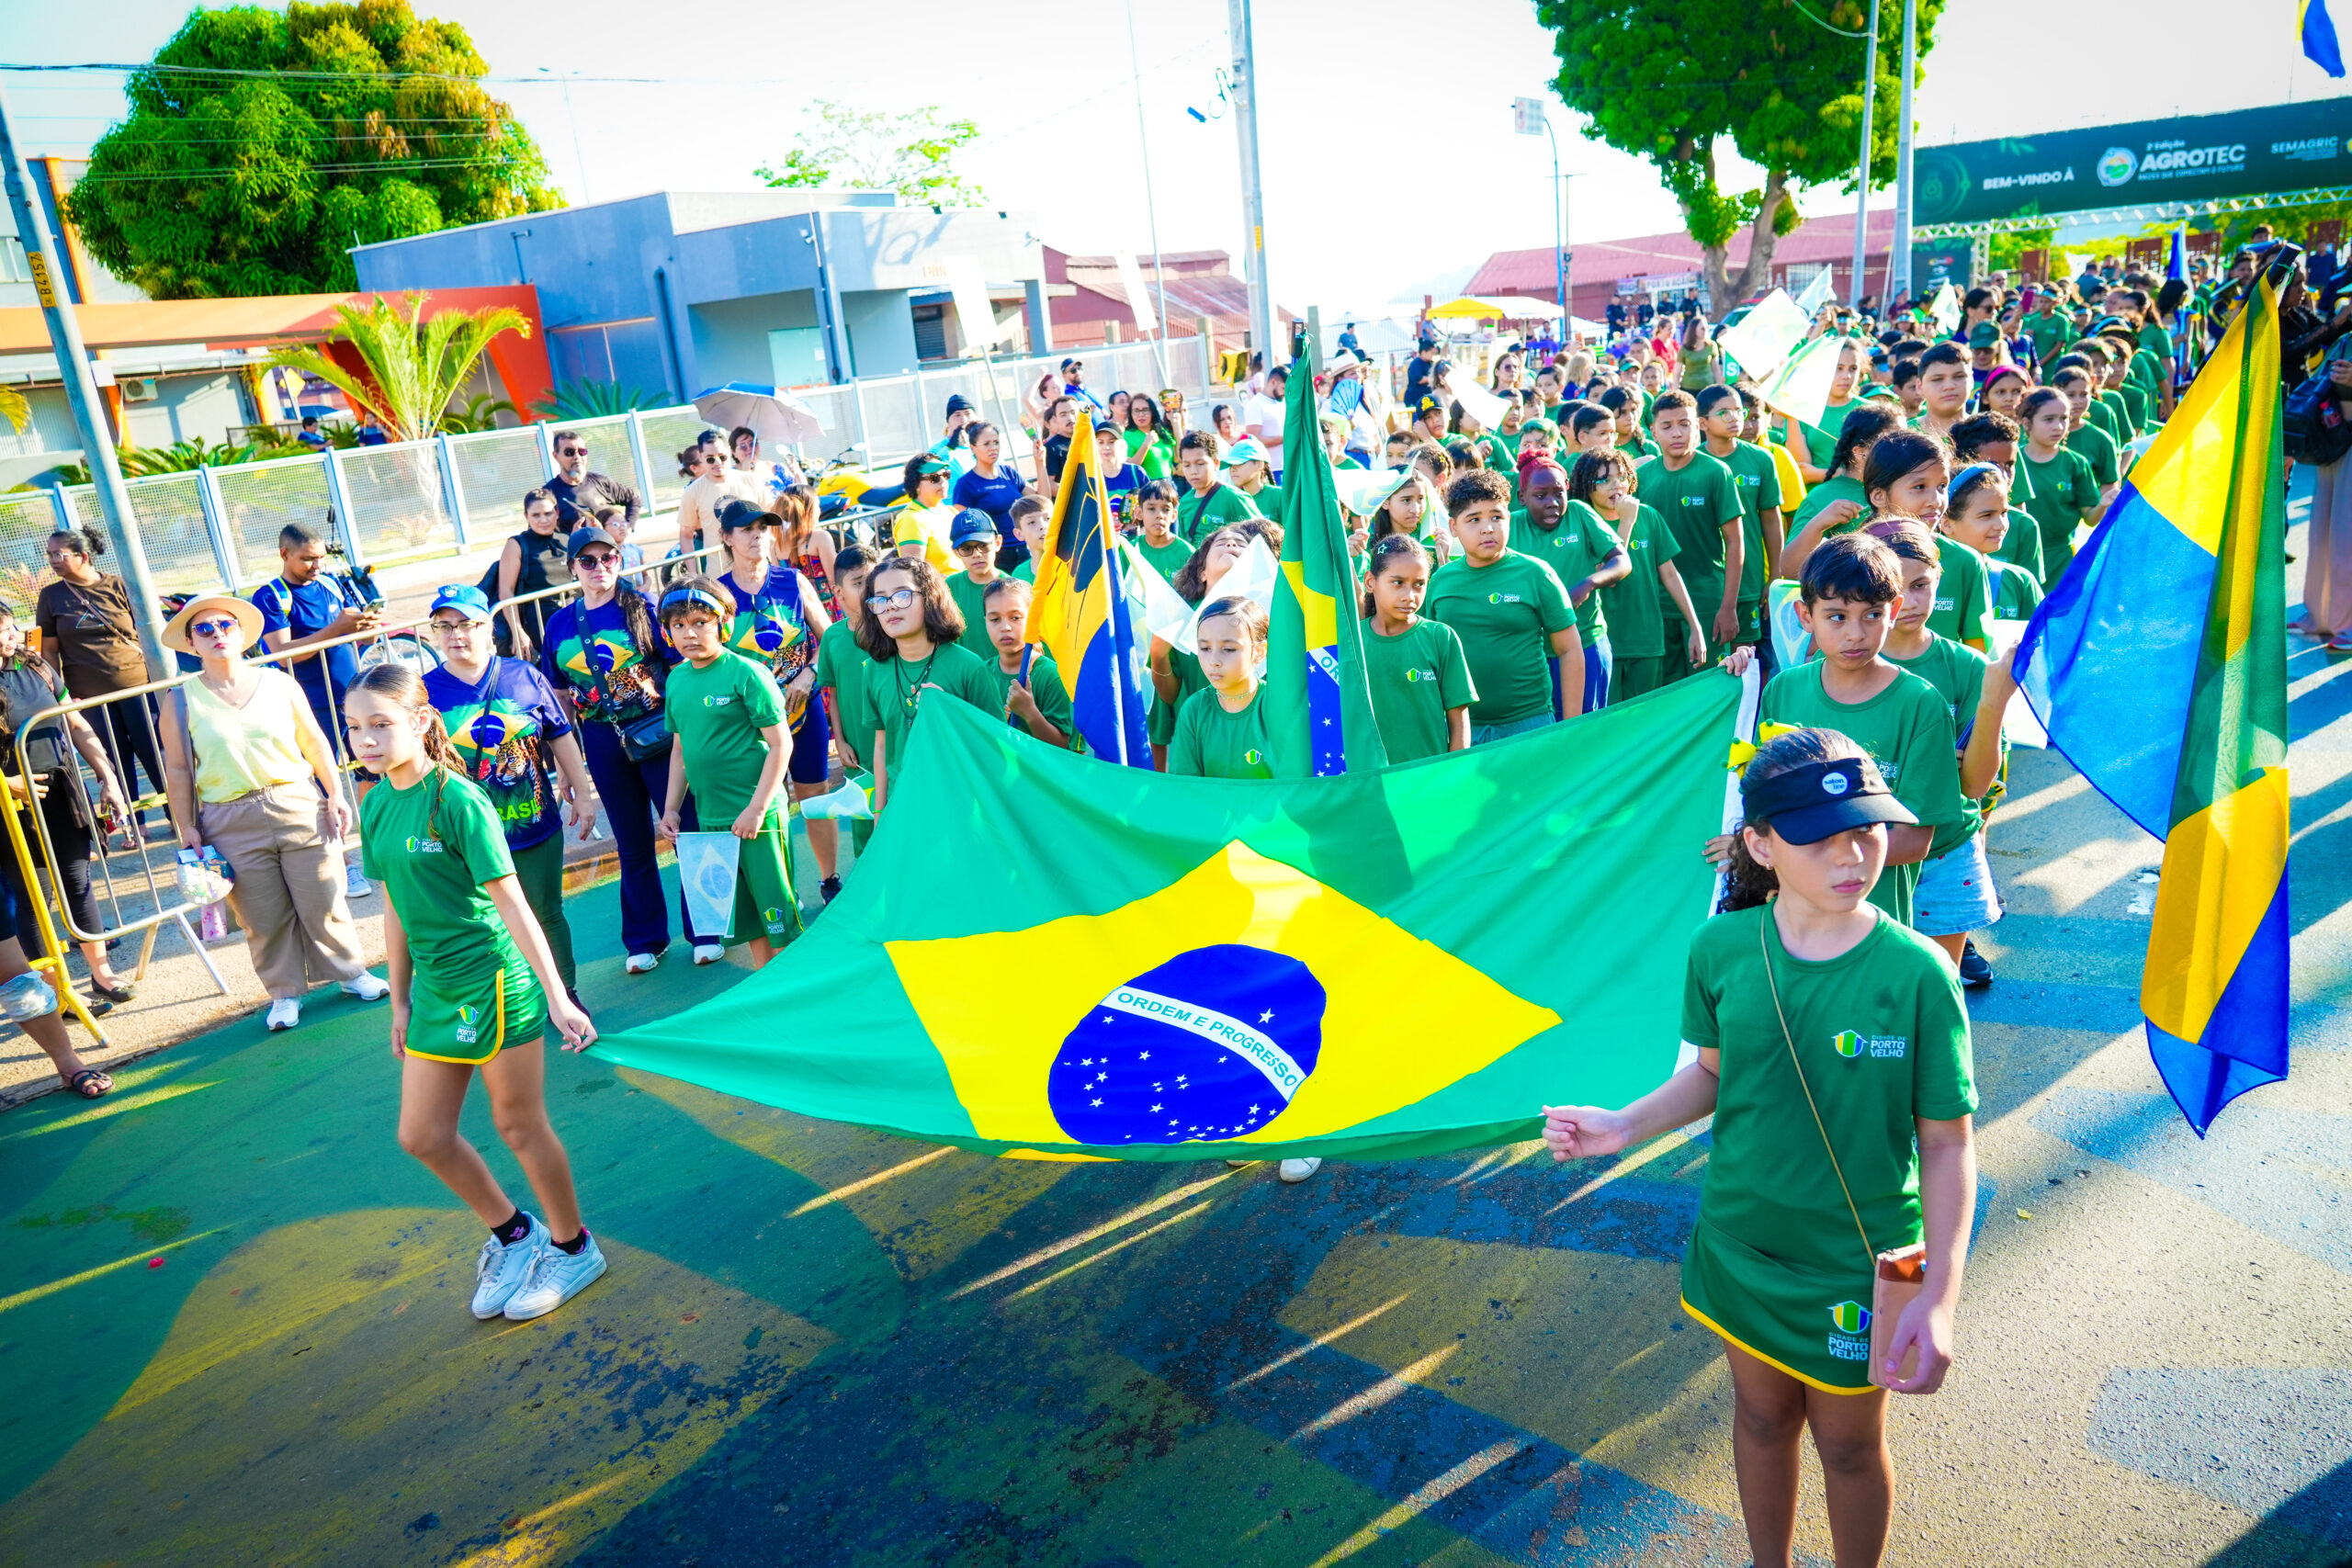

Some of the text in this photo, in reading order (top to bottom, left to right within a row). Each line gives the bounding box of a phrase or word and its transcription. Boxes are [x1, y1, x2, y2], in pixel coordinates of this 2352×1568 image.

[2271, 136, 2338, 154] SEMAGRIC
[2139, 143, 2247, 173] AGROTEC
[1983, 171, 2063, 191] BEM-VINDO
[30, 254, 51, 294] B4157
[457, 1034, 477, 1043] VELHO
[1117, 992, 1298, 1088] ORDEM E PROGRESSO
[1871, 1040, 1905, 1049] PORTO
[1870, 1049, 1905, 1058] VELHO
[1828, 1332, 1857, 1342] CIDADE
[1828, 1337, 1869, 1352] PORTO
[1828, 1345, 1869, 1360] VELHO
